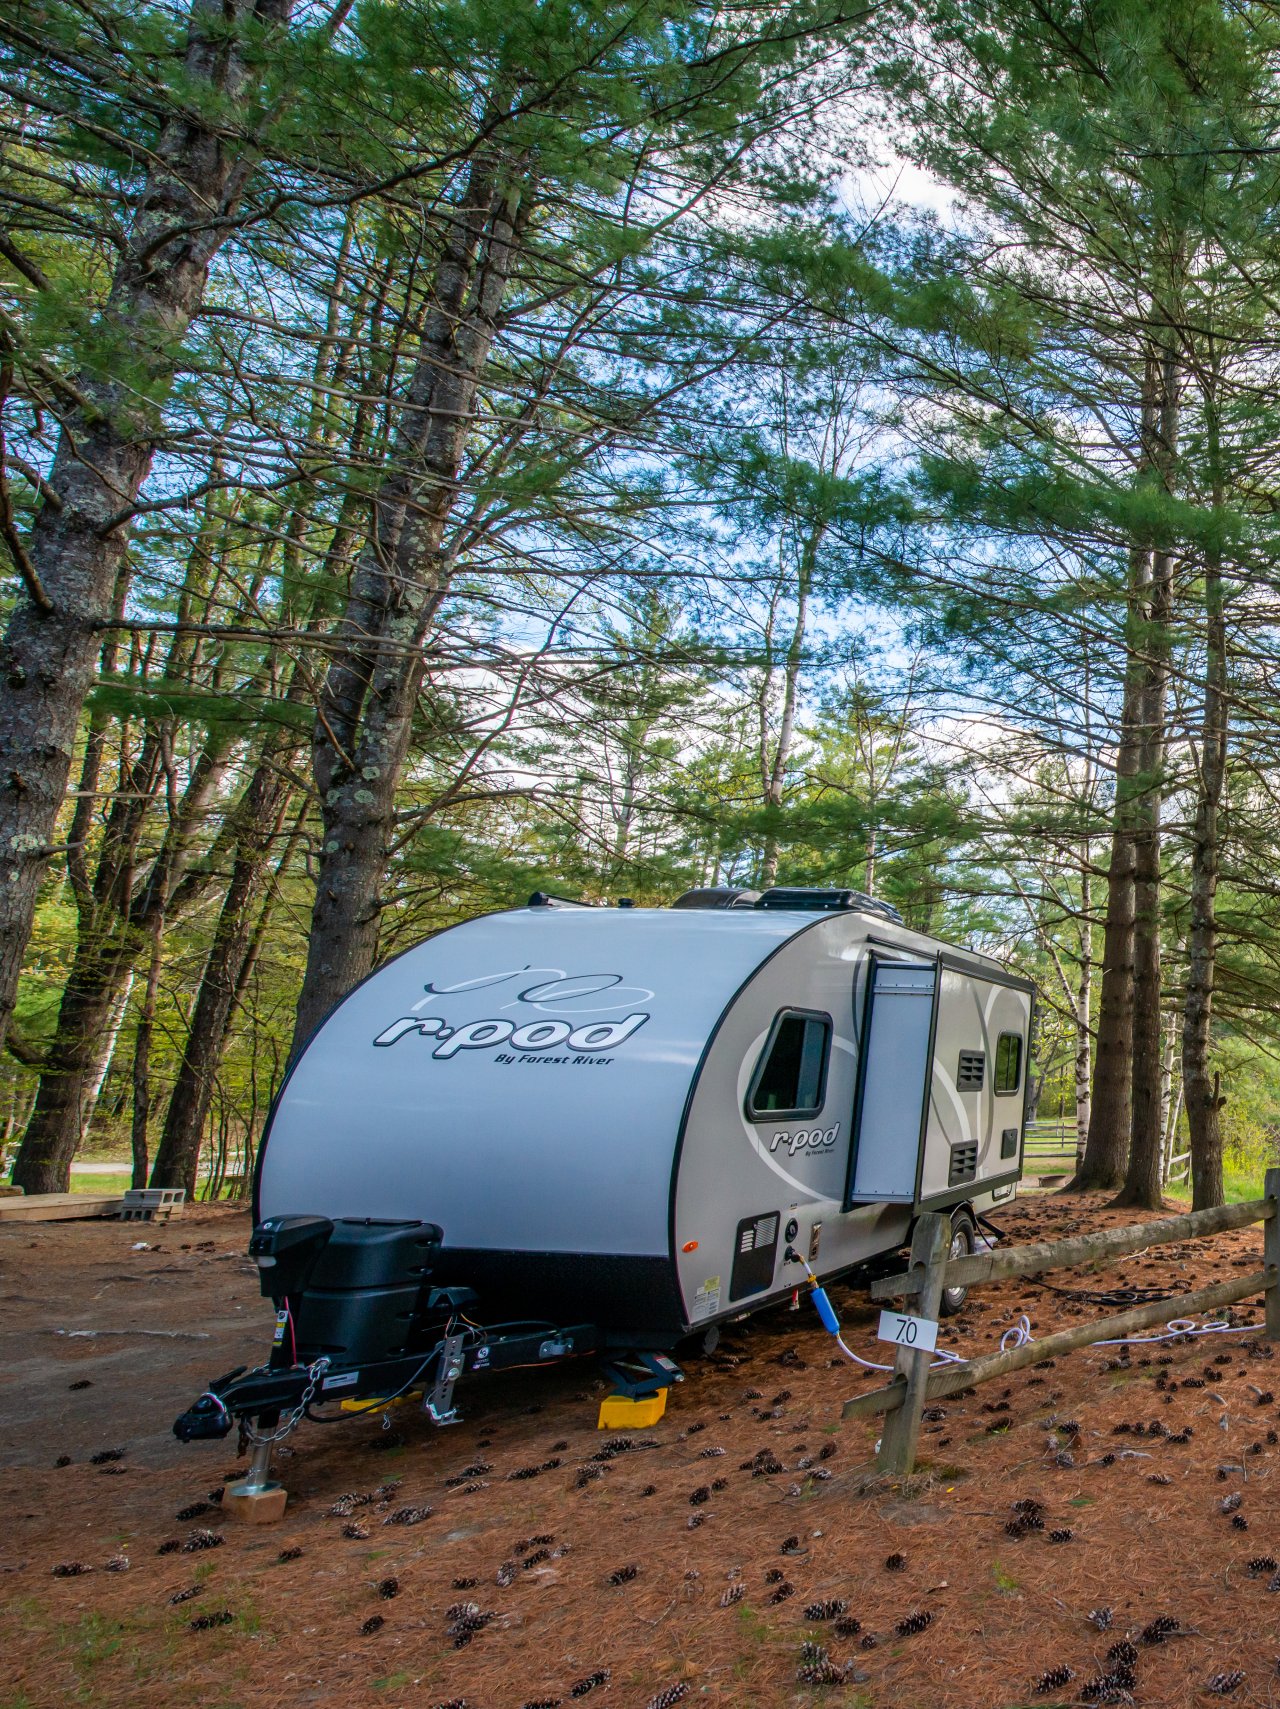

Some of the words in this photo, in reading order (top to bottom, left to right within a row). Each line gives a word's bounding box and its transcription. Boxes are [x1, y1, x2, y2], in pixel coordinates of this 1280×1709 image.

[495, 1054, 516, 1065] By
[518, 1054, 570, 1064] Forest
[572, 1056, 614, 1065] River
[896, 1318, 917, 1343] 70
